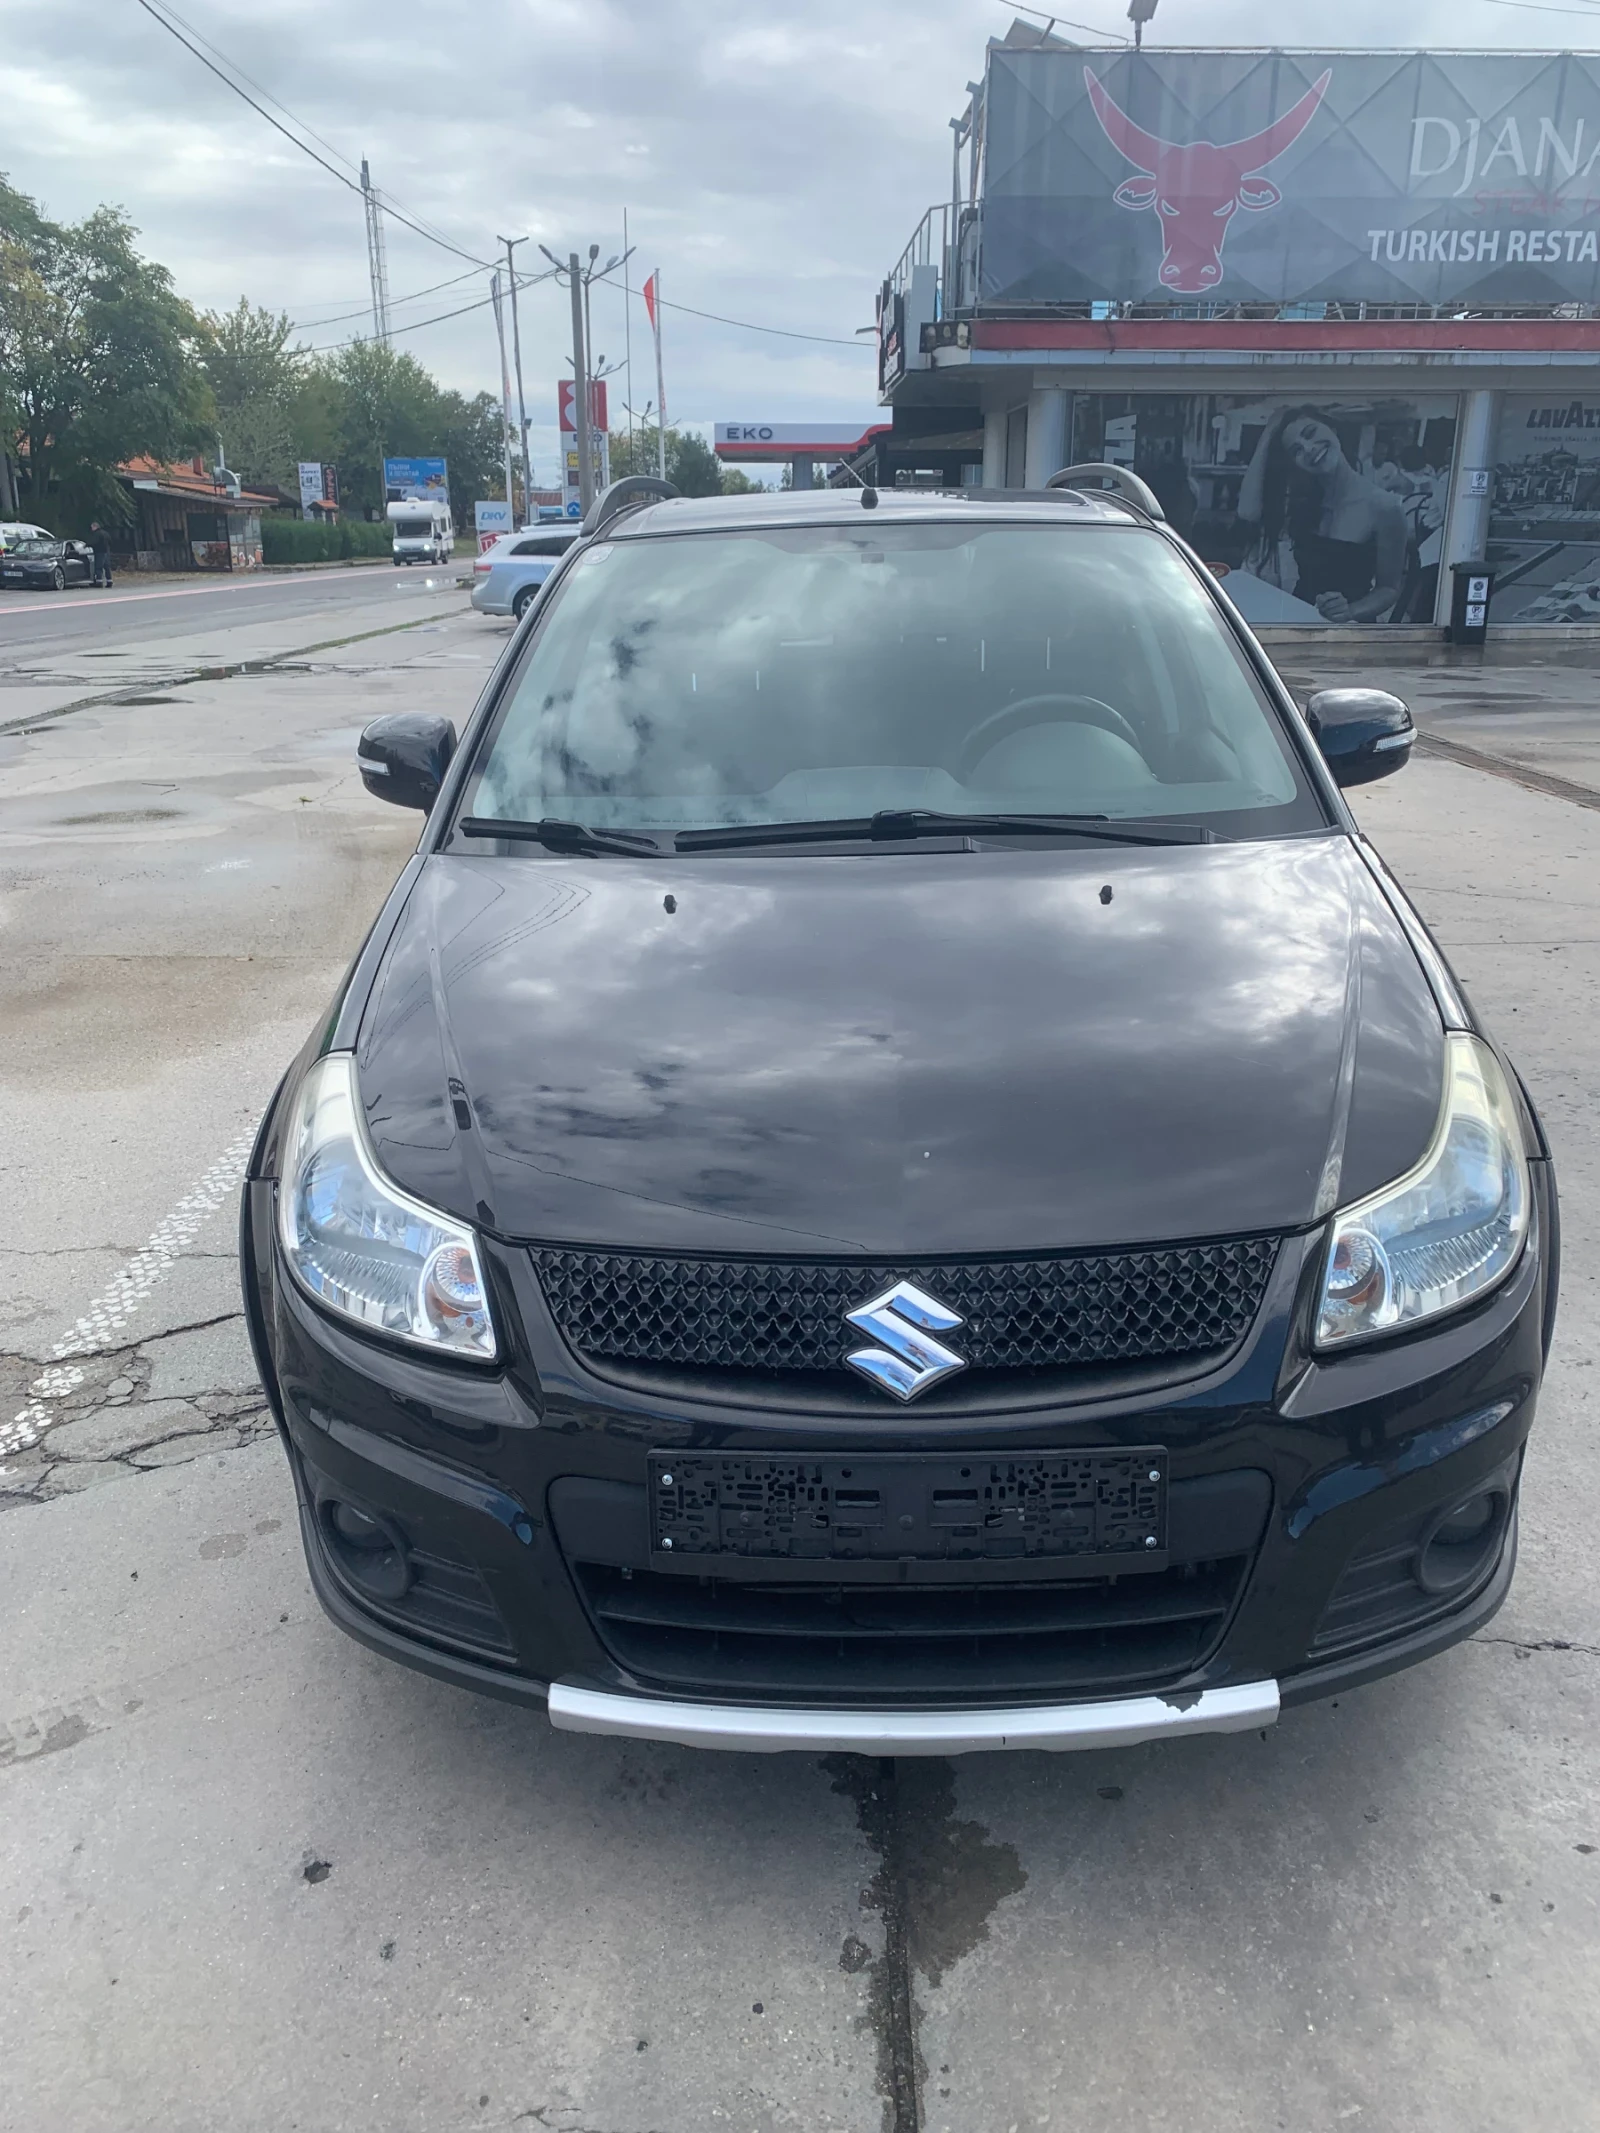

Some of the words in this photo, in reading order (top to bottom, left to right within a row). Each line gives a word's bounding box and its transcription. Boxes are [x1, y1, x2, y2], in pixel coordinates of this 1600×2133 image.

[1368, 229, 1500, 263] TURKISH
[726, 427, 773, 440] EKO
[481, 511, 507, 521] DKV
